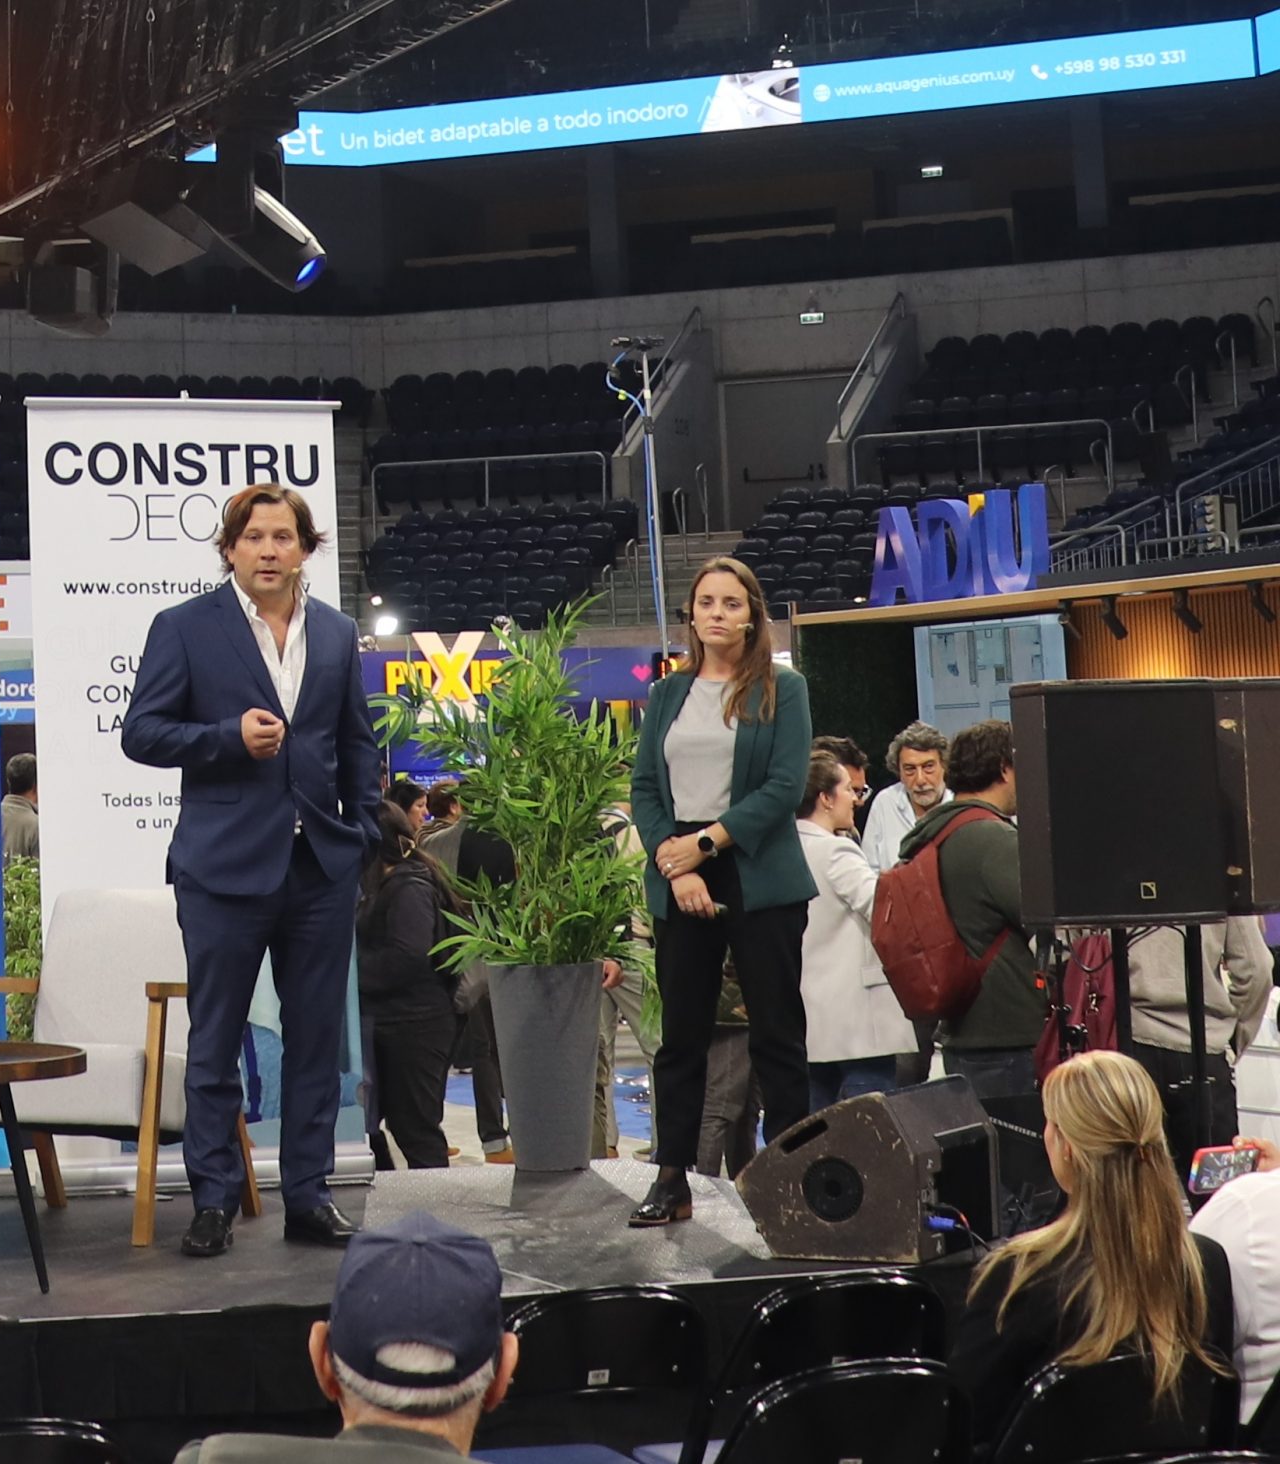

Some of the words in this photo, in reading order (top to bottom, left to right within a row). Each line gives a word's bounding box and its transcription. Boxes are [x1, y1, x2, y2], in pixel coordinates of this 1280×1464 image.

[1055, 59, 1094, 76] +598
[1098, 56, 1121, 71] 98
[1125, 52, 1156, 69] 530
[1160, 49, 1187, 65] 331
[835, 68, 1016, 97] www.aquagenius.com.uy
[281, 123, 325, 156] et
[340, 132, 368, 150] Un
[374, 126, 425, 149] bidet
[430, 115, 531, 143] adaptable
[537, 120, 549, 132] a
[554, 110, 602, 130] todo
[607, 101, 689, 125] inodoro
[44, 441, 320, 487] CONSTRU
[107, 493, 231, 542] DEC
[86, 684, 133, 704] CON
[101, 792, 153, 808] Todas
[158, 791, 182, 807] las
[136, 819, 147, 829] a
[152, 818, 173, 829] un
